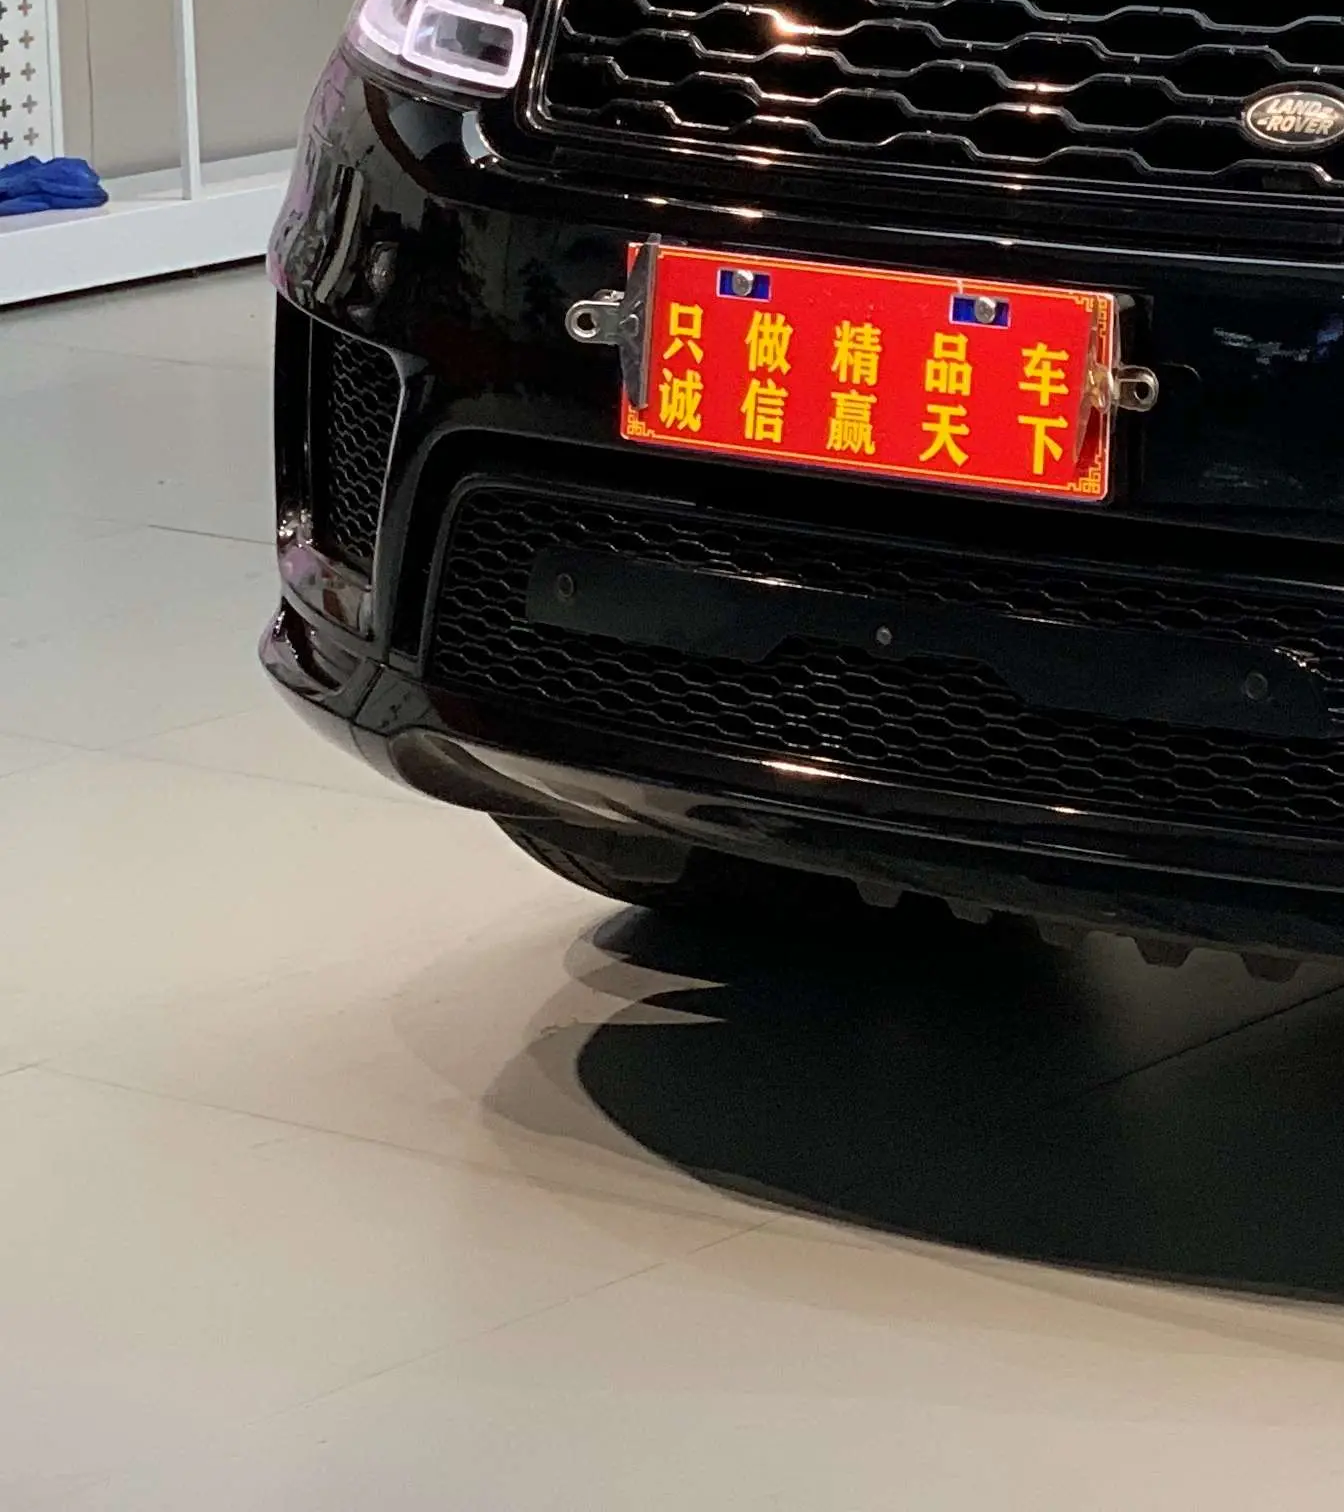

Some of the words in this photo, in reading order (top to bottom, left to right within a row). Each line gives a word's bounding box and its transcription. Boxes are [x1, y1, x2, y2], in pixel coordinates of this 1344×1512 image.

[1265, 114, 1334, 135] ROVER
[1266, 98, 1322, 115] LAND
[662, 302, 1069, 407] 只做精品车
[658, 367, 1064, 476] 诚信赢天下
